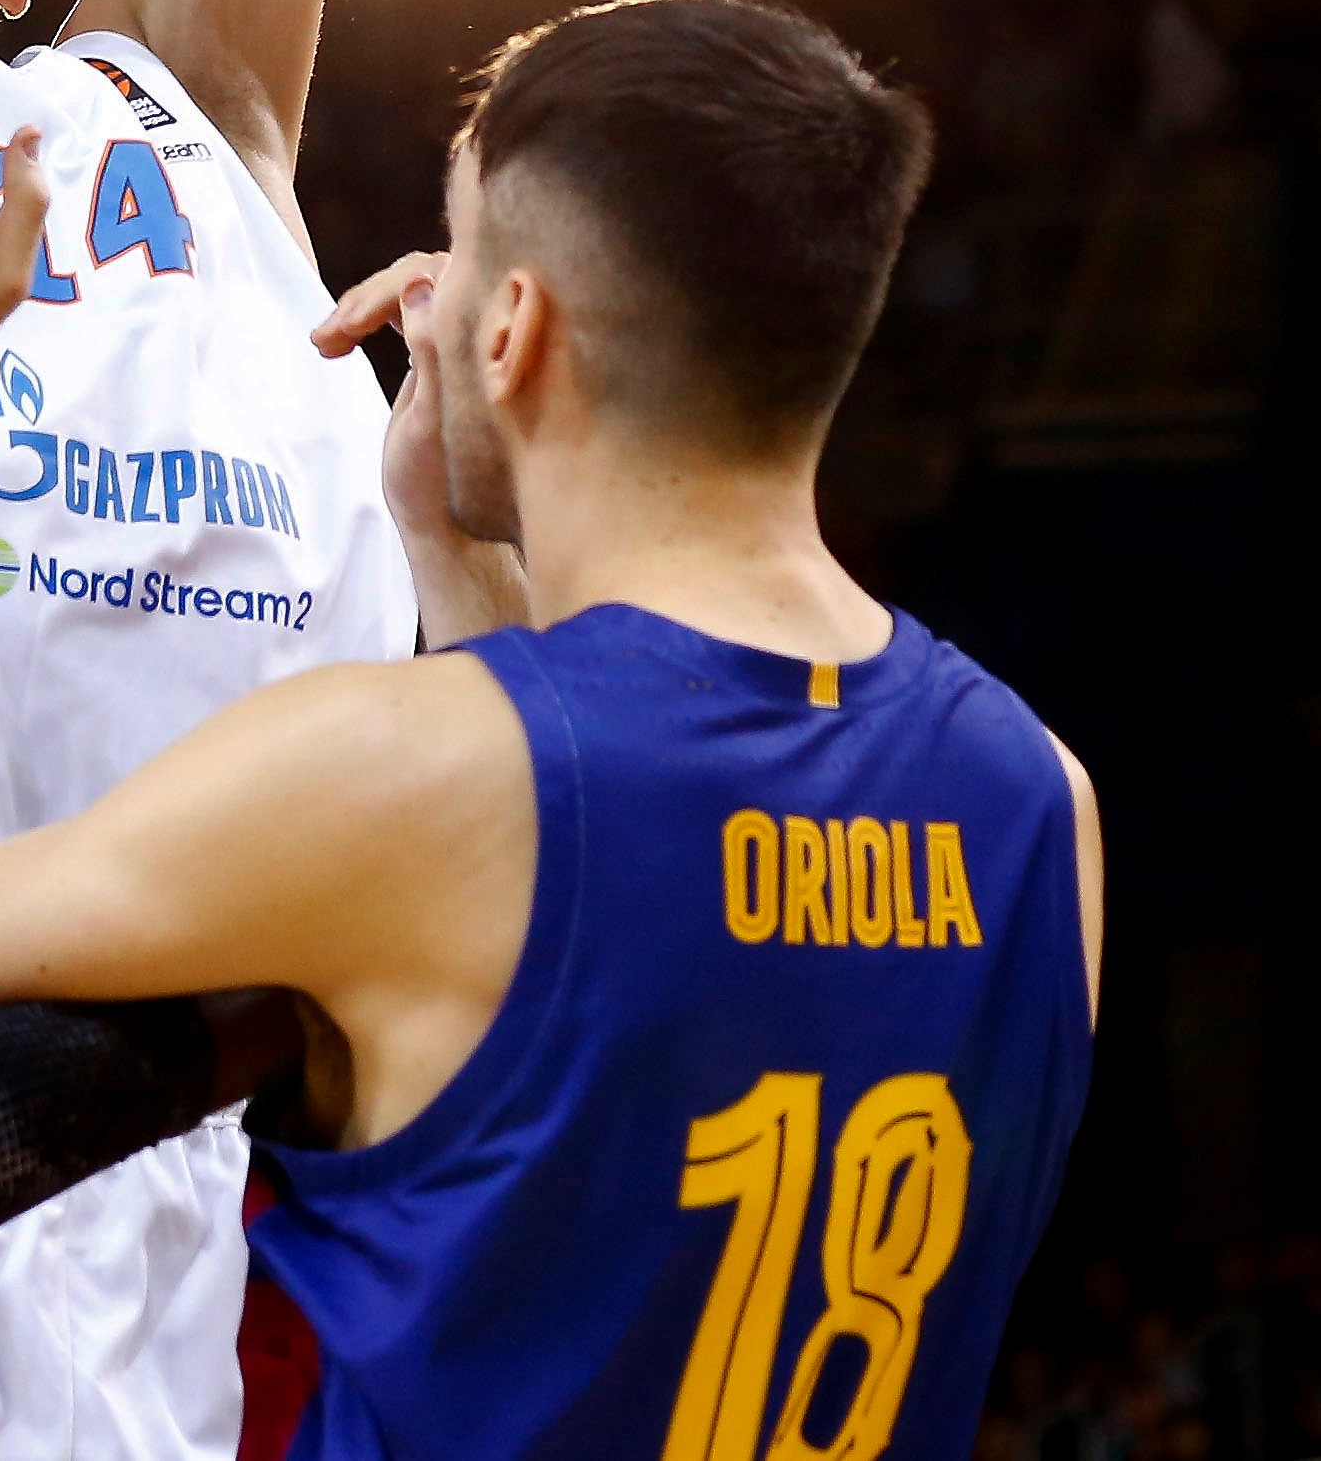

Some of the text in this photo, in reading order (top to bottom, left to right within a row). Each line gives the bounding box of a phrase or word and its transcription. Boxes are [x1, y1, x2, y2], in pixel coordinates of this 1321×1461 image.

[64, 438, 301, 540] GAZPROM
[28, 552, 314, 632] Nord Stream 2
[722, 808, 983, 948] ORIOLA
[661, 1071, 974, 1461] 18
